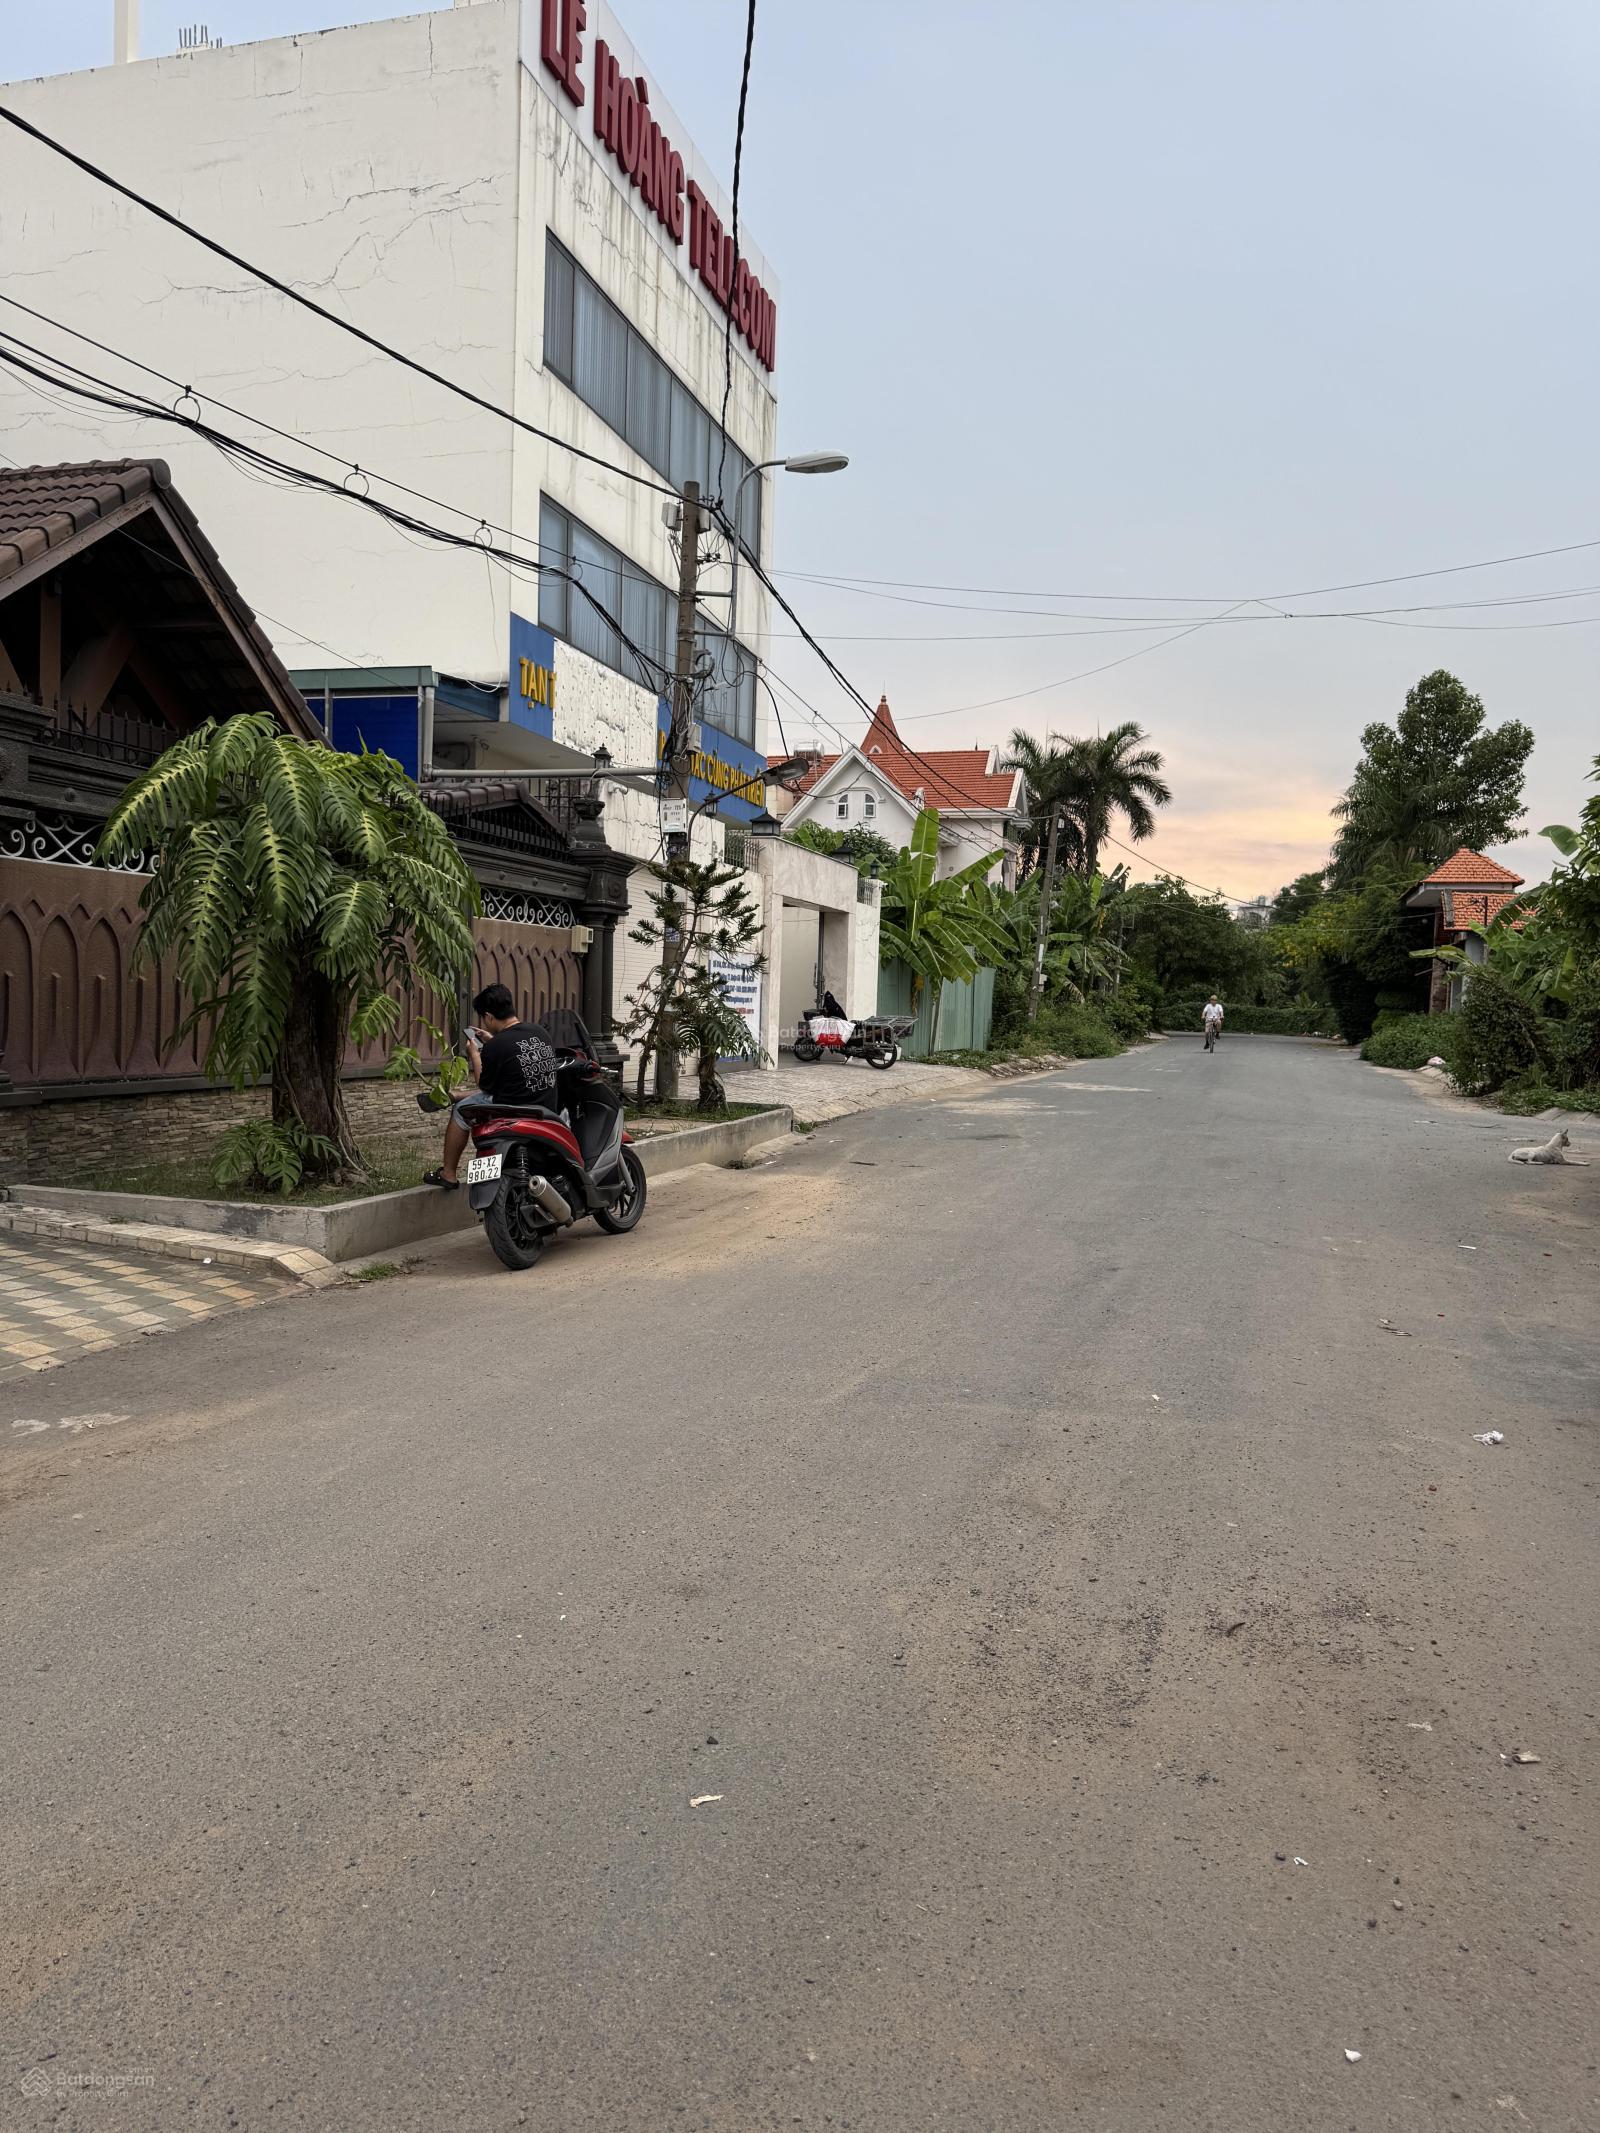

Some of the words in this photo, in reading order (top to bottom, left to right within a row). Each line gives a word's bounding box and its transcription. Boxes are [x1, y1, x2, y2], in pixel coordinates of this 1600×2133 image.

[594, 39, 685, 246] HOÀNG
[472, 1156, 497, 1170] 59-X2
[468, 1167, 499, 1182] 980.22
